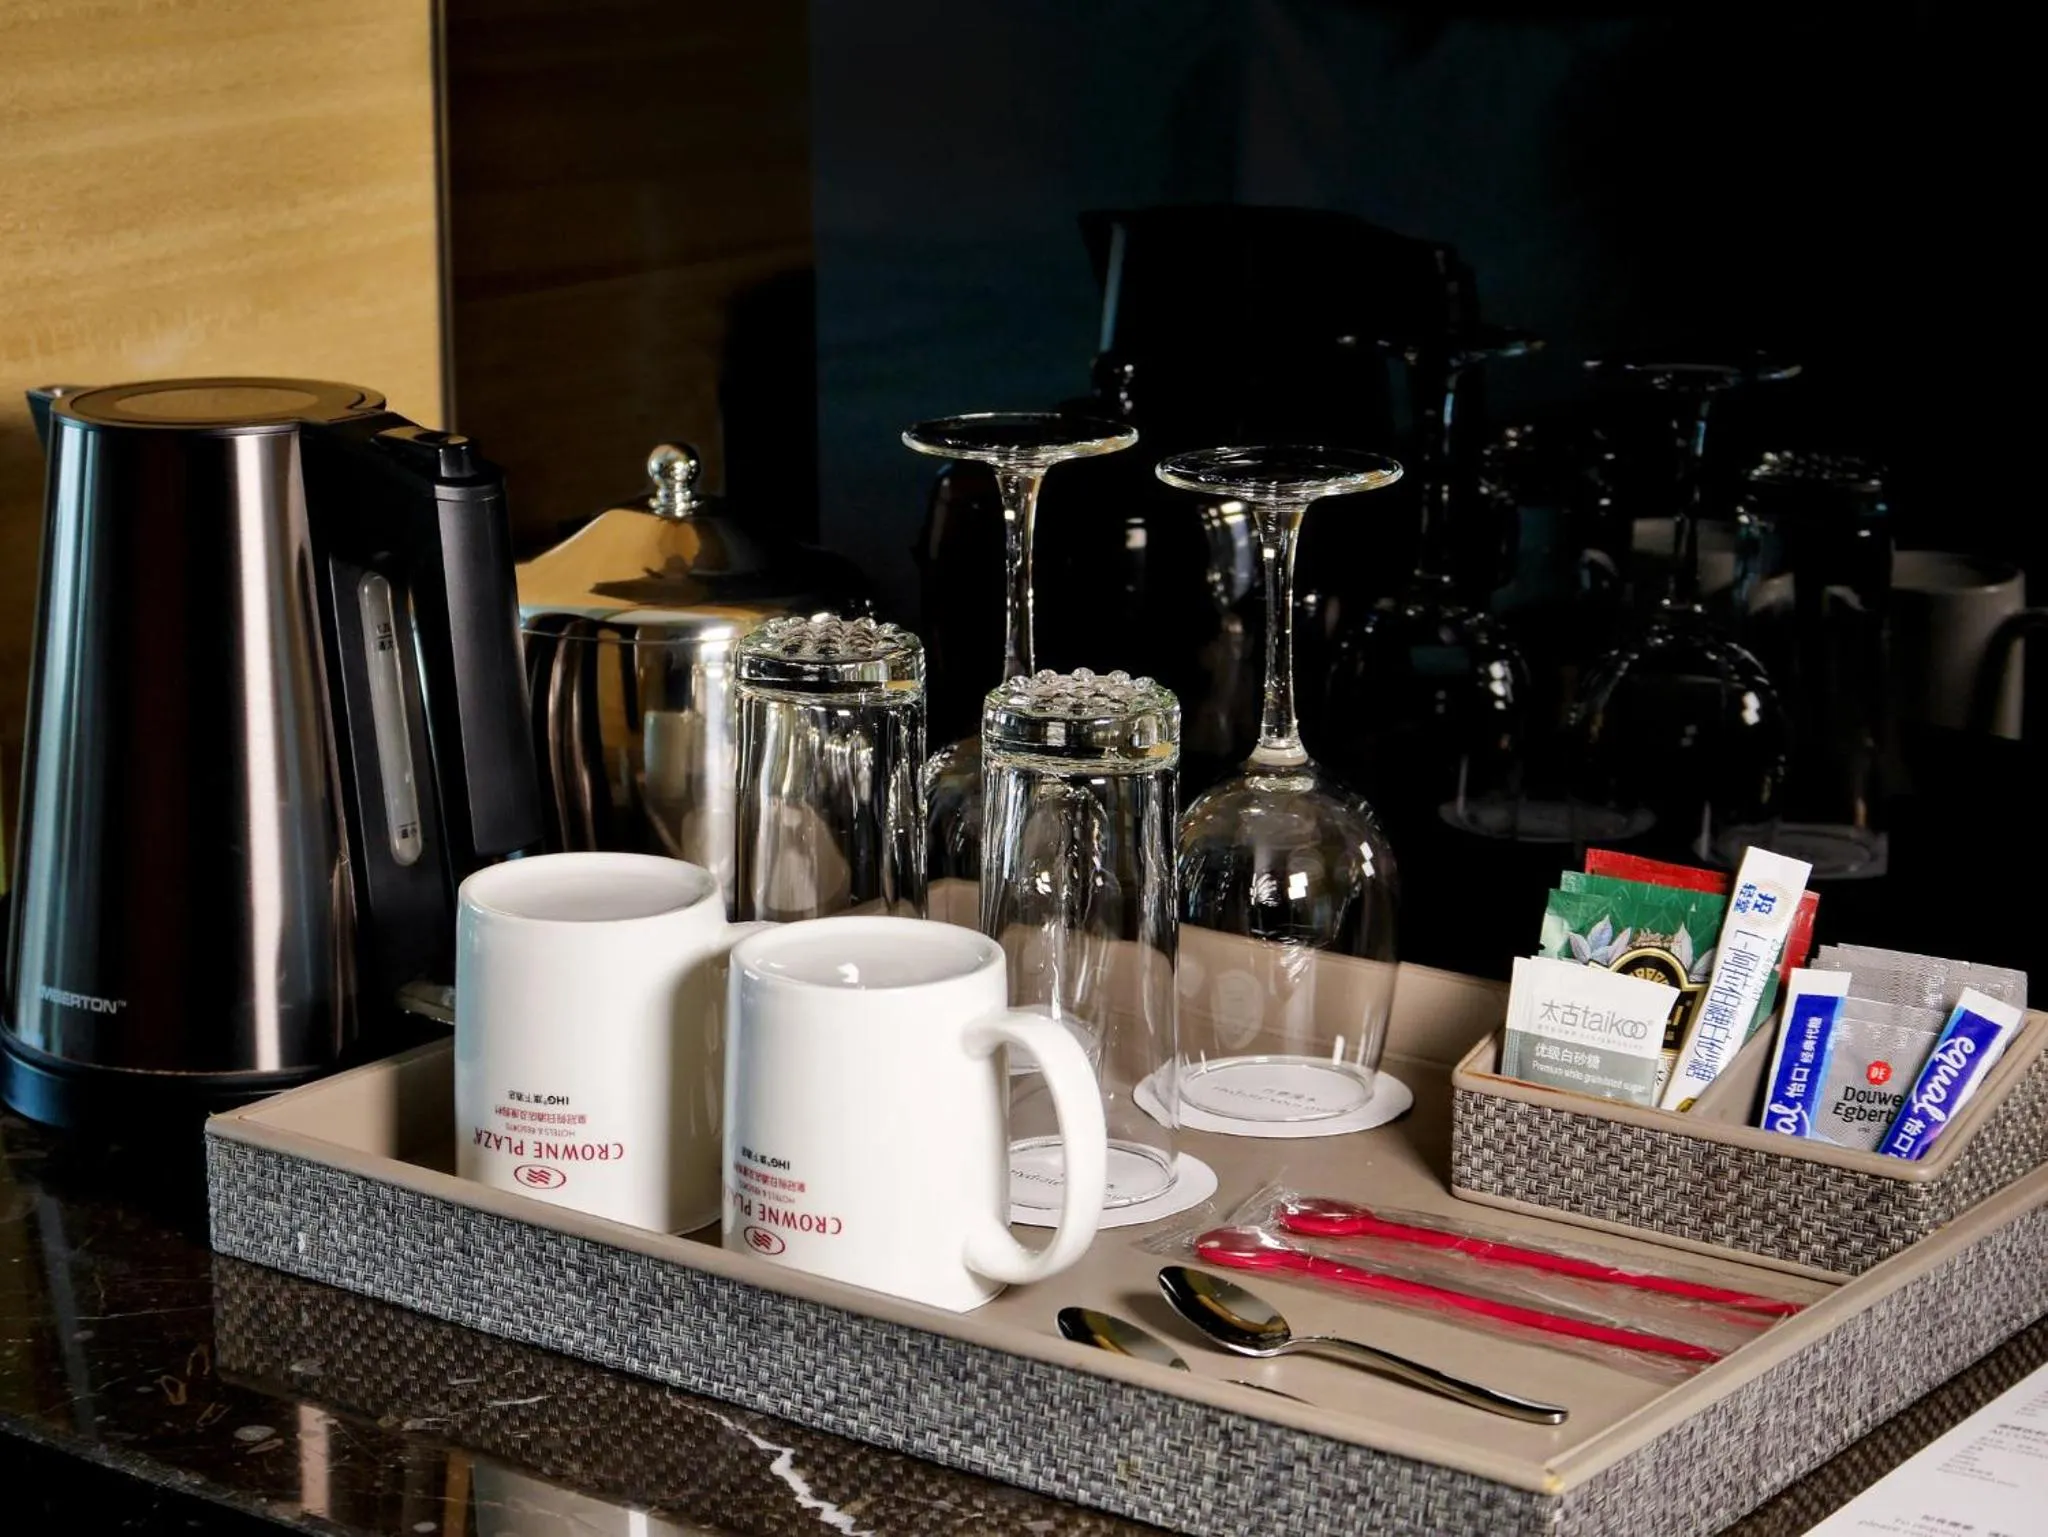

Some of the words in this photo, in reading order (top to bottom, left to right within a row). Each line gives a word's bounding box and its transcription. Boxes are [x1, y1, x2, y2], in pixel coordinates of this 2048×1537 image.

[1912, 1036, 1976, 1123] equal
[1843, 1086, 1904, 1108] Douwe
[1832, 1101, 1895, 1124] Egbert
[533, 1141, 625, 1161] CROWNE
[758, 1203, 842, 1235] CROWNE
